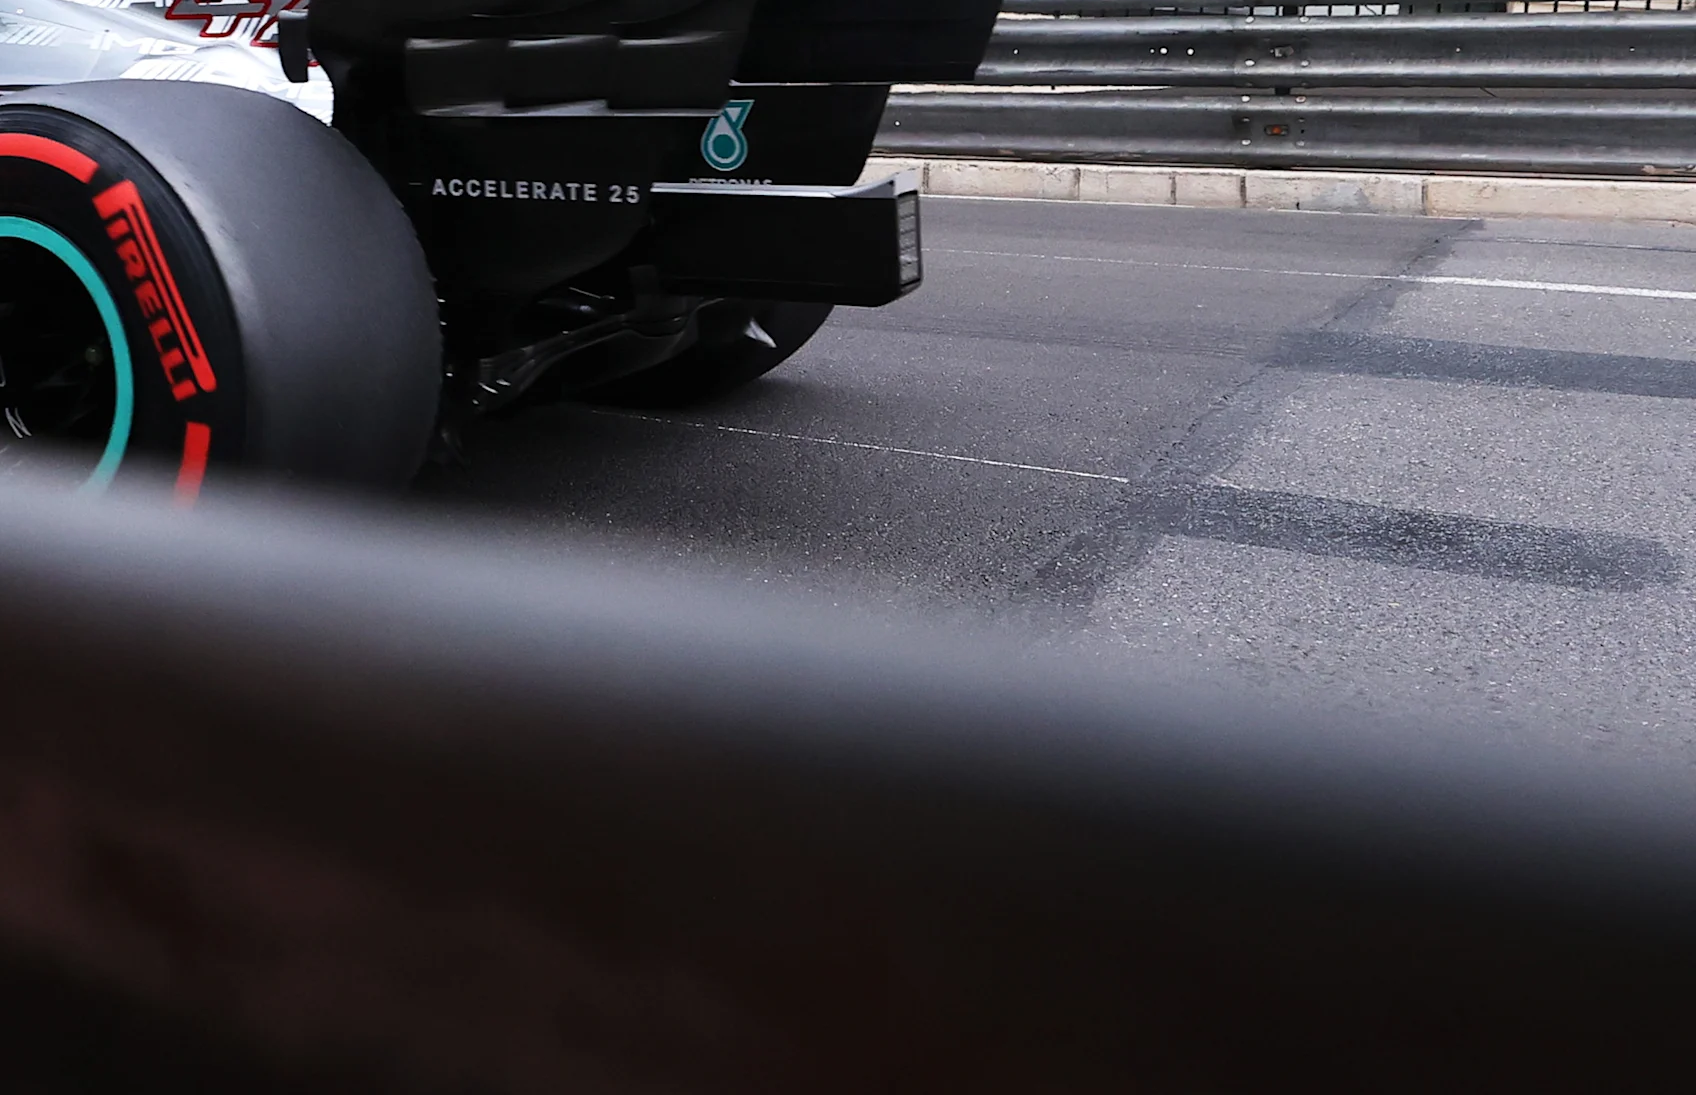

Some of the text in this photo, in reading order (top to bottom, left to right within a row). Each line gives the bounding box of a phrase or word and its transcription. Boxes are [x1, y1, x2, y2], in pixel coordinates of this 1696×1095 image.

[432, 179, 640, 204] ACCELERATE 25
[92, 179, 217, 401] PIRELLI
